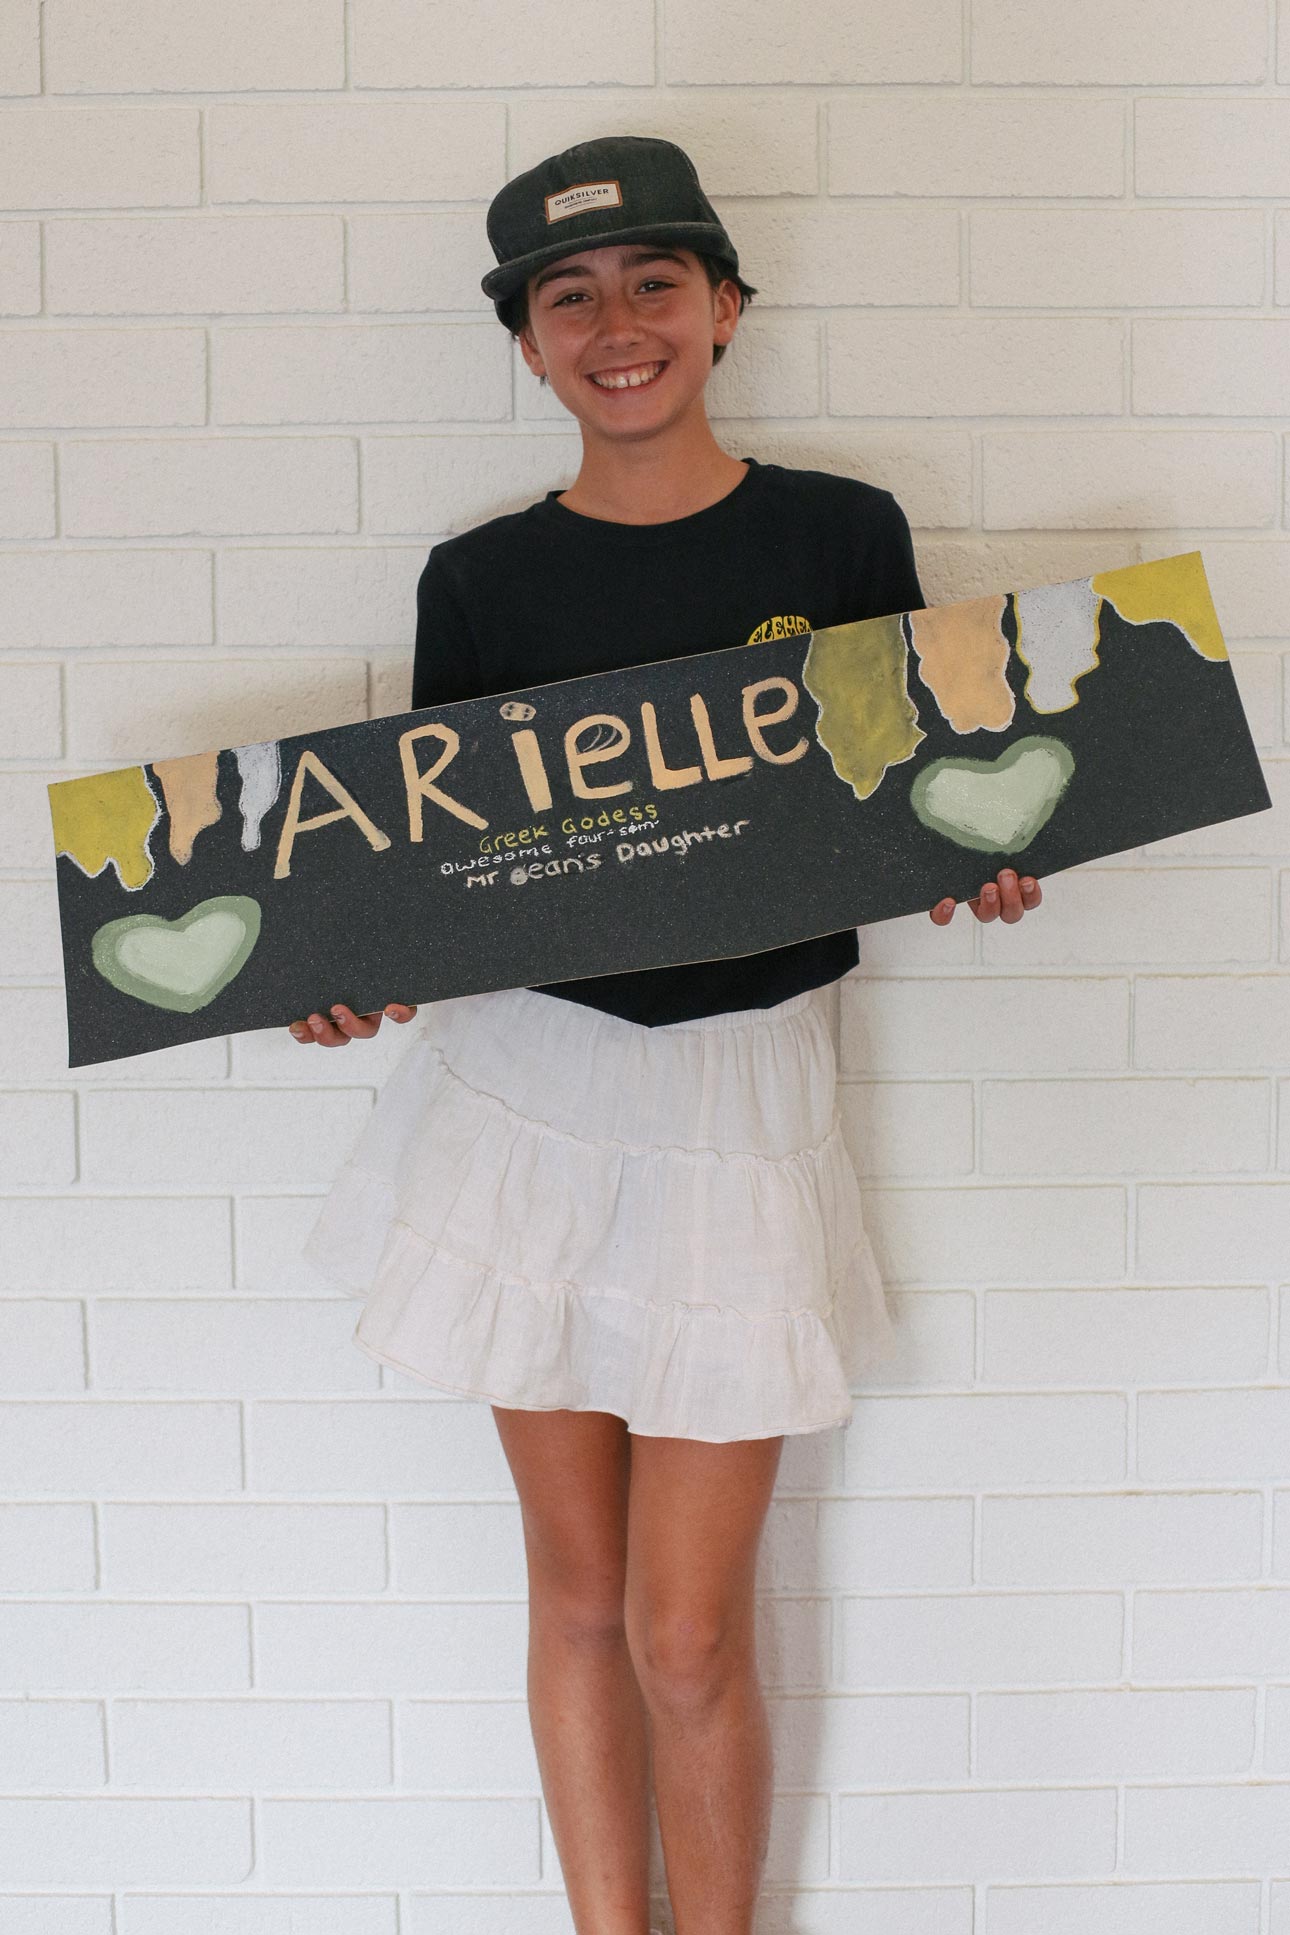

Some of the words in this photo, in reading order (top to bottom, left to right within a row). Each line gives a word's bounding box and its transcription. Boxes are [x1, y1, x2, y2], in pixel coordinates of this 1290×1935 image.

[554, 188, 609, 206] QUIKSILVER
[479, 824, 549, 854] Greek
[561, 803, 658, 834] Godess
[440, 844, 552, 875] awesome
[466, 870, 499, 888] Mr
[616, 820, 750, 863] Daughter
